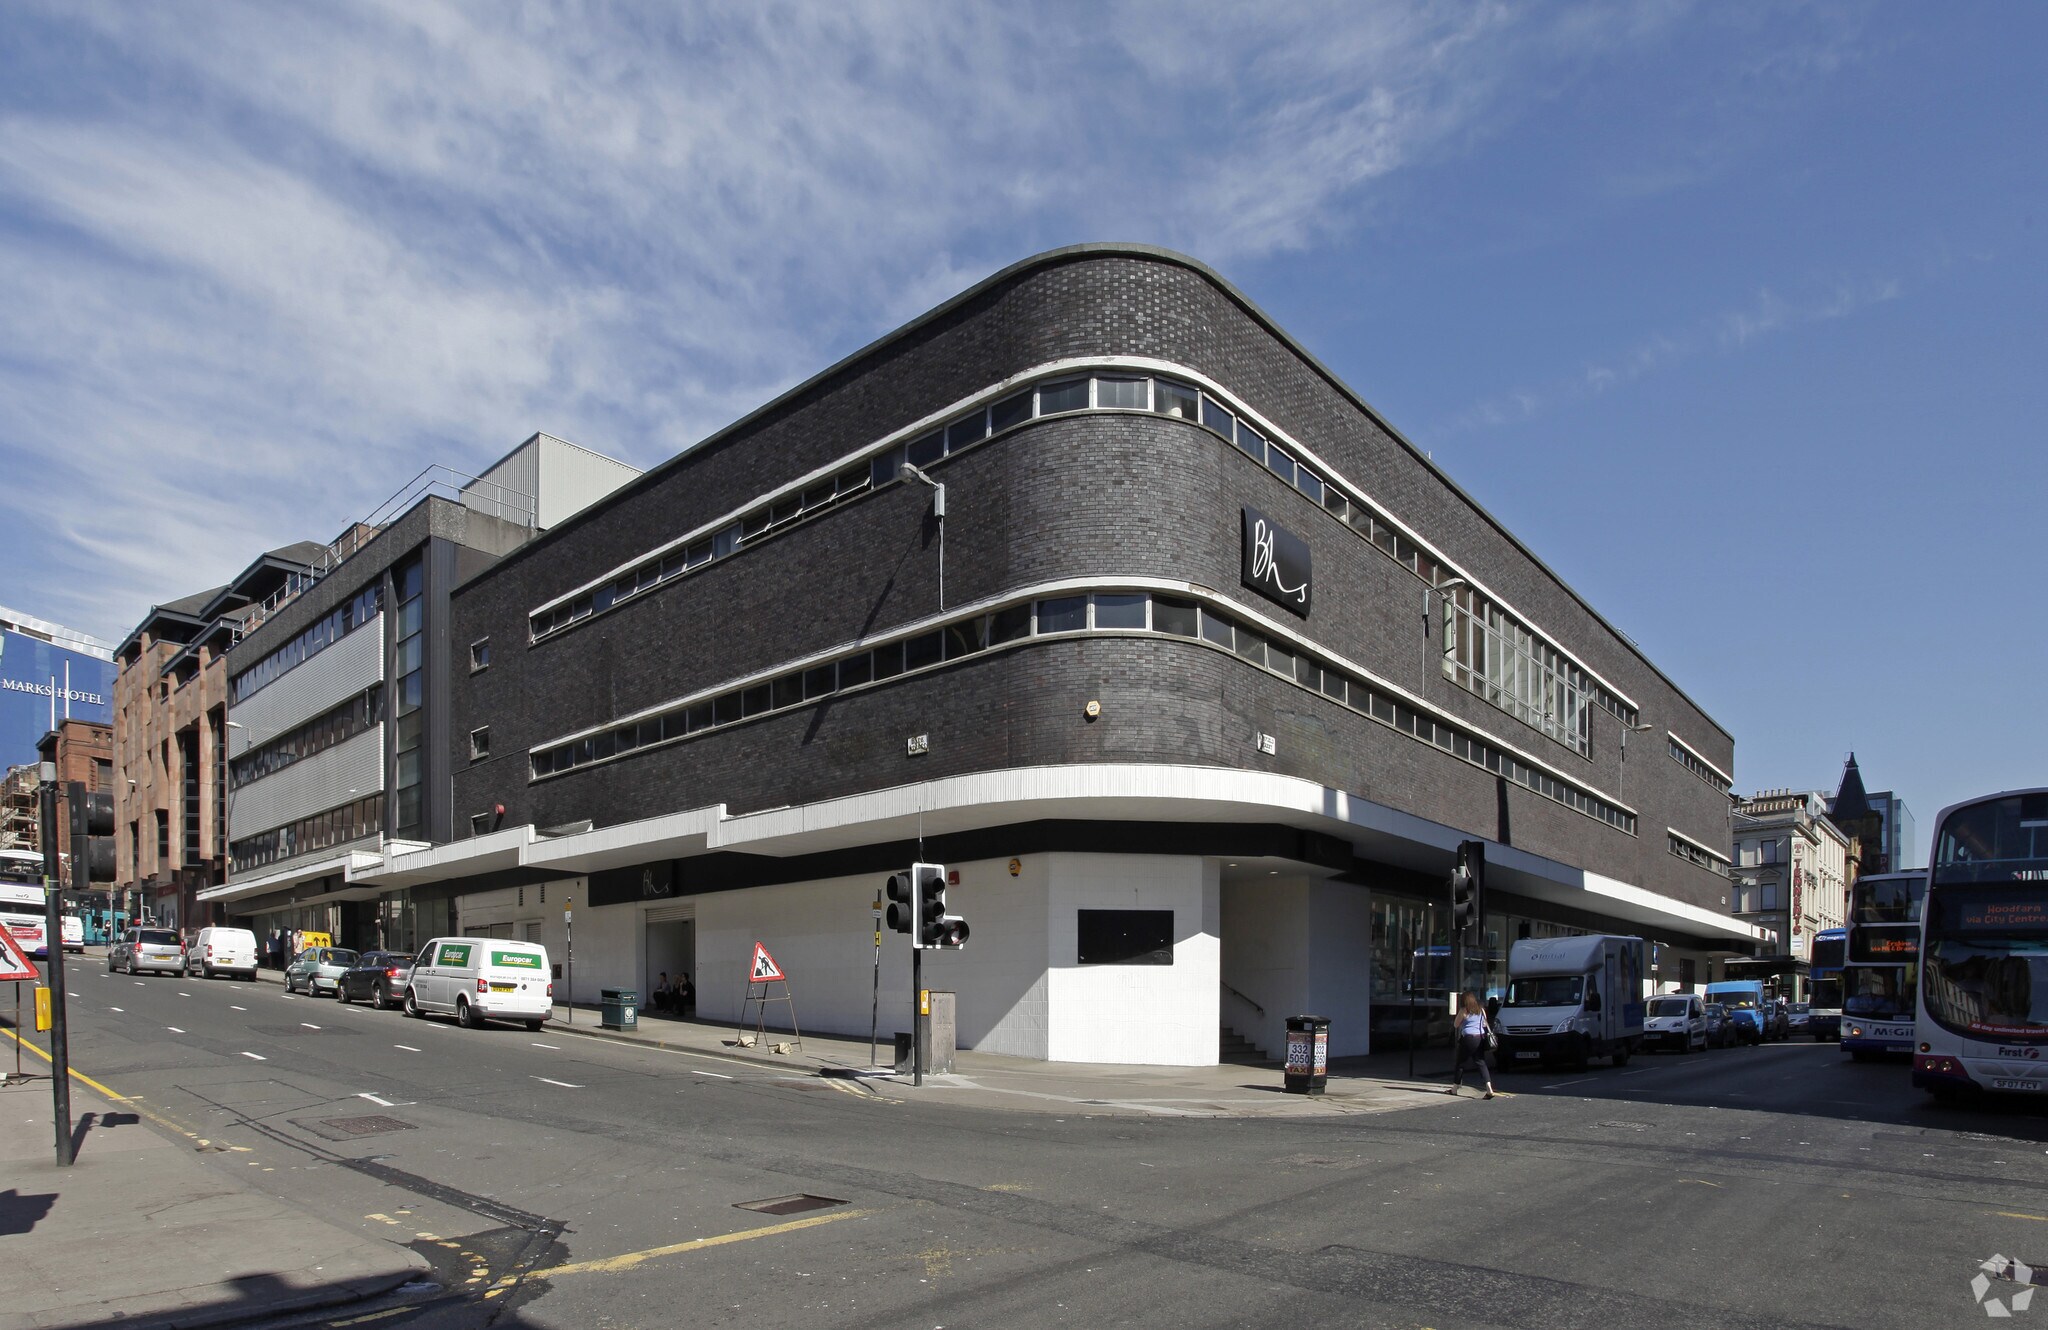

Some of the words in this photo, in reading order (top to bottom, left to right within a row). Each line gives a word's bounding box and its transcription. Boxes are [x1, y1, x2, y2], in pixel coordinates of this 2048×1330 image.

[1252, 518, 1307, 603] Bhs
[2, 678, 52, 697] MARKS
[57, 687, 105, 705] HOTEL
[1987, 904, 2042, 914] Woodfarm
[1984, 915, 2005, 924] City
[444, 949, 464, 959] Europcar
[502, 954, 533, 963] Europcar
[1873, 1027, 1914, 1037] McGil
[1292, 1044, 1308, 1054] 332
[1998, 1046, 2022, 1057] First
[1289, 1054, 1310, 1064] 5050
